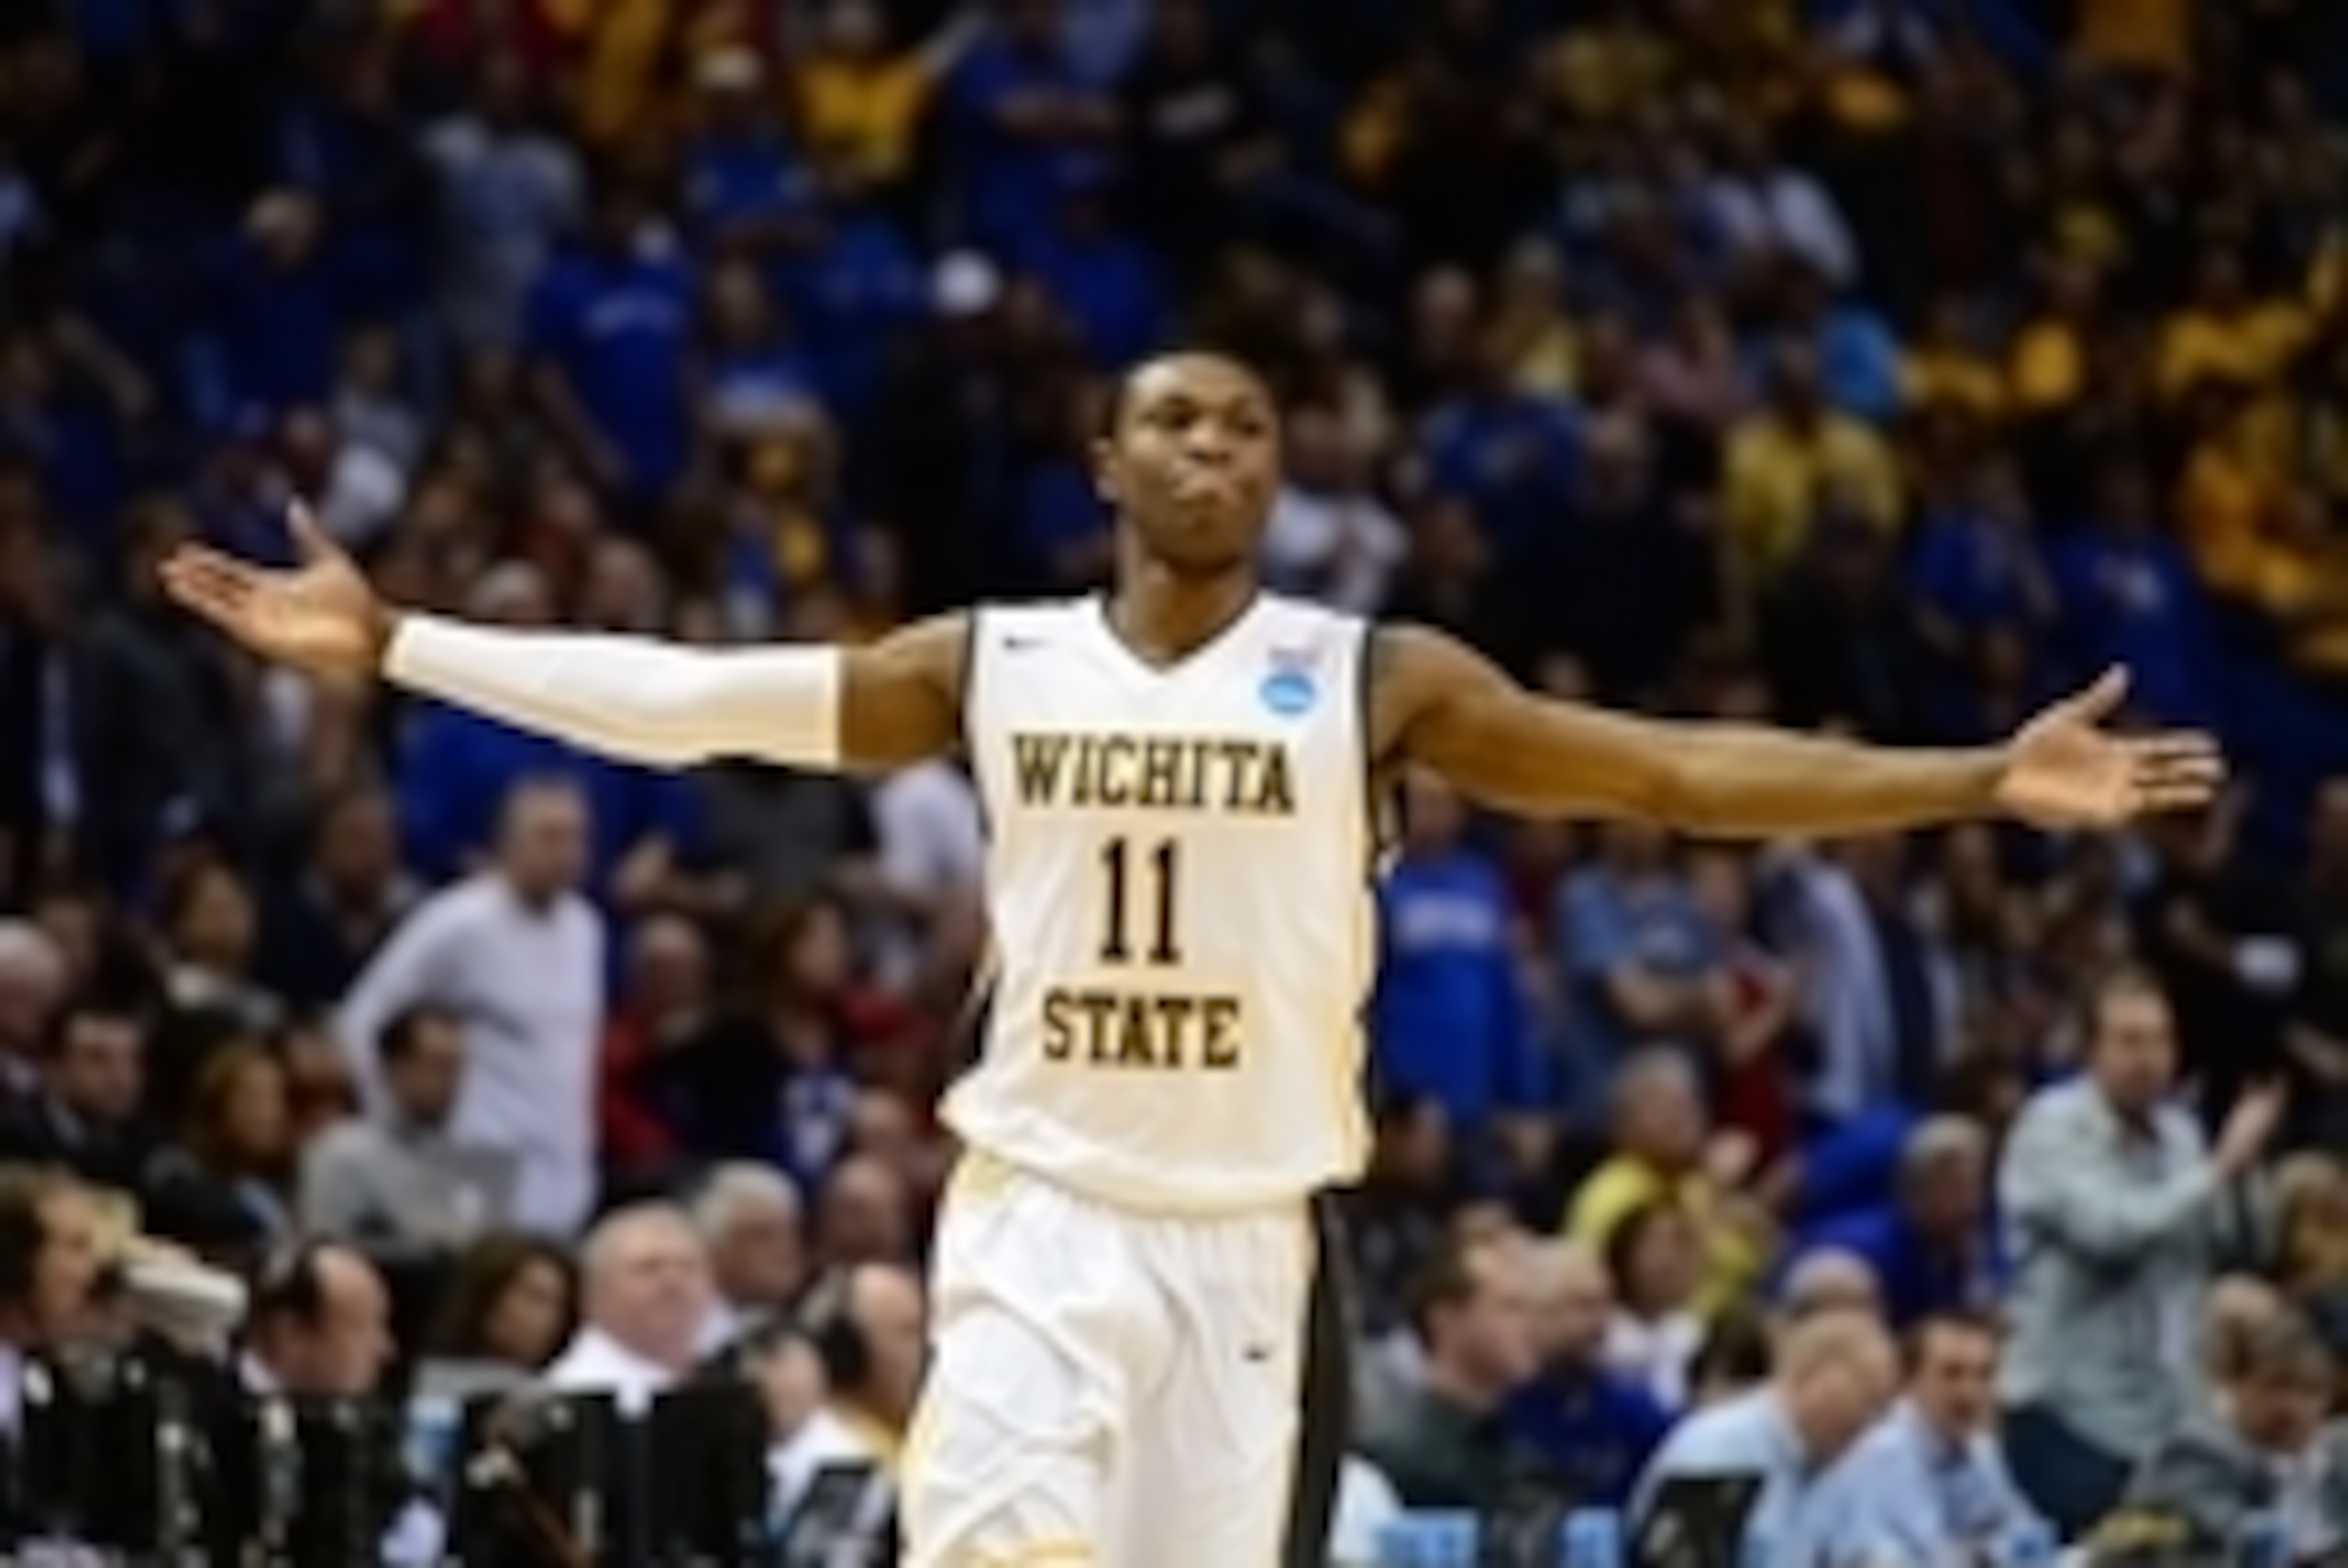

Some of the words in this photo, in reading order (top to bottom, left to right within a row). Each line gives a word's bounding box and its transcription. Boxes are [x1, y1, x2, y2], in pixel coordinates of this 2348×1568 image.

[1013, 733, 1295, 815] WICHITA
[1100, 836, 1180, 966] 11
[1043, 988, 1240, 1069] STATE
